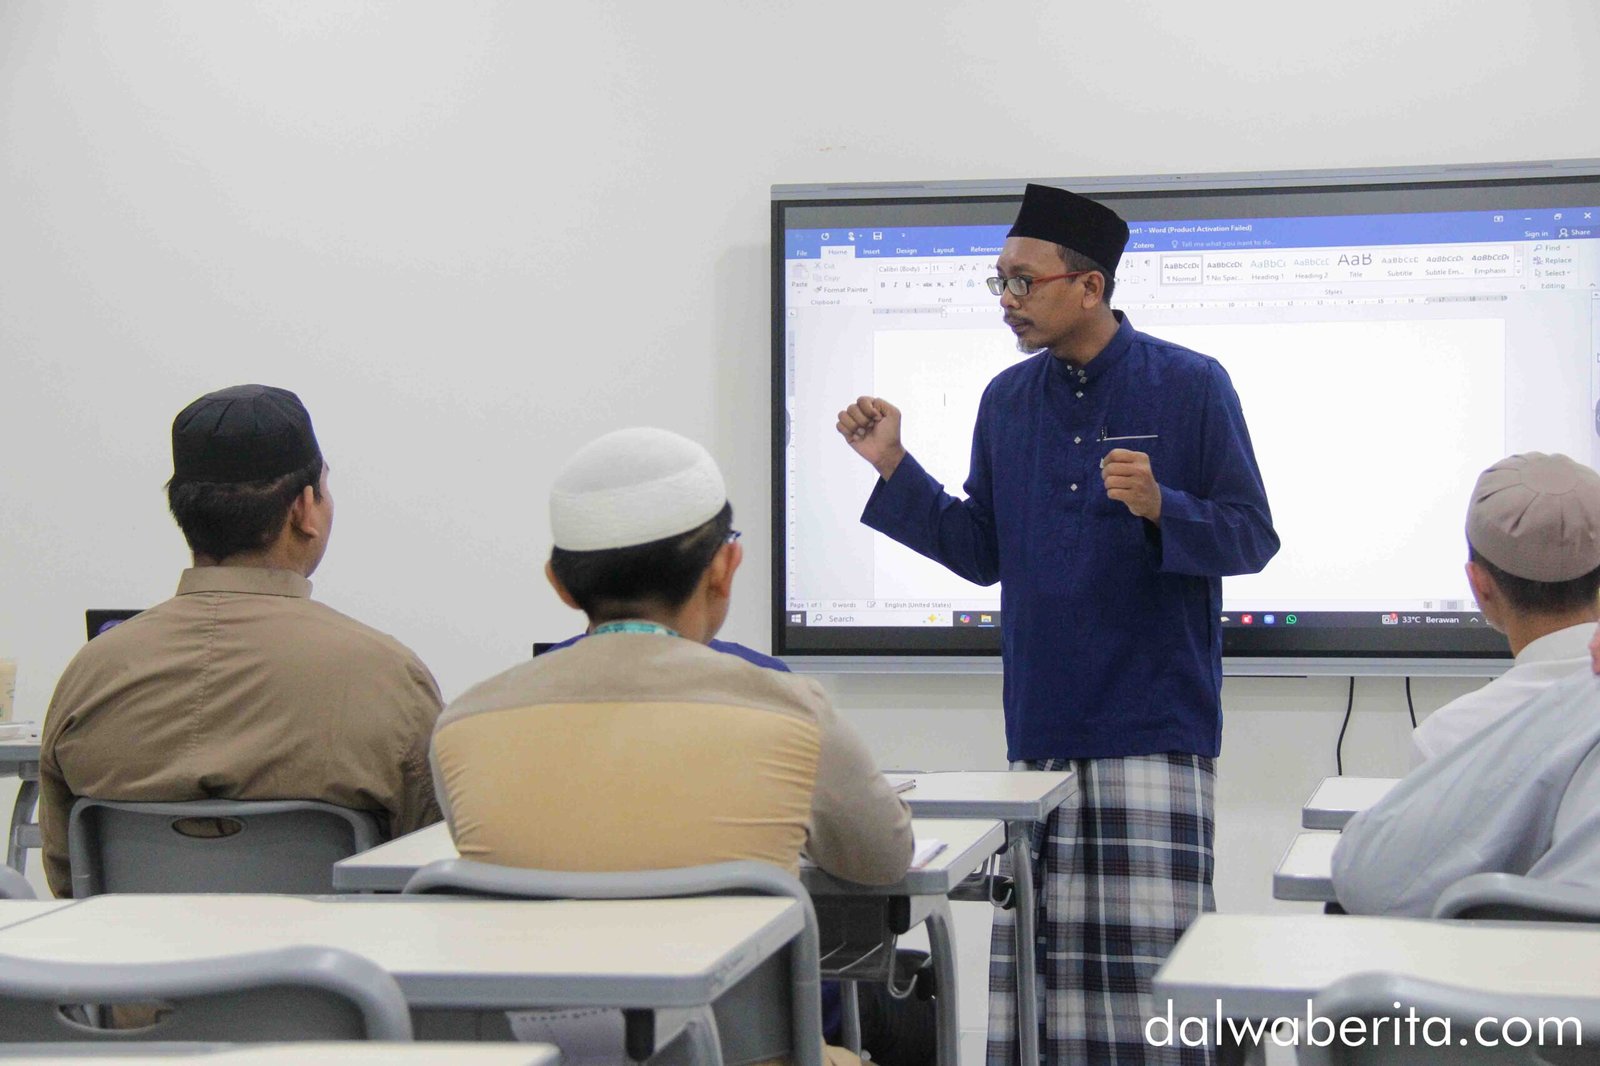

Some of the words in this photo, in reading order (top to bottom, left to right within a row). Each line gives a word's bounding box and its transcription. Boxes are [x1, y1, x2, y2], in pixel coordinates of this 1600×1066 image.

[1168, 226, 1196, 234] (Product
[1196, 225, 1229, 233] Activation
[797, 249, 808, 257] File
[896, 247, 917, 255] Design
[900, 265, 920, 273] (Body)
[1474, 267, 1506, 275] Emphasis
[1545, 269, 1566, 277] Select
[1252, 273, 1279, 281] Heading
[1541, 282, 1565, 290] Editing
[1324, 288, 1343, 296] Styles
[829, 615, 854, 623] Search
[1402, 616, 1421, 624] 33°C
[1425, 616, 1460, 624] Berawan
